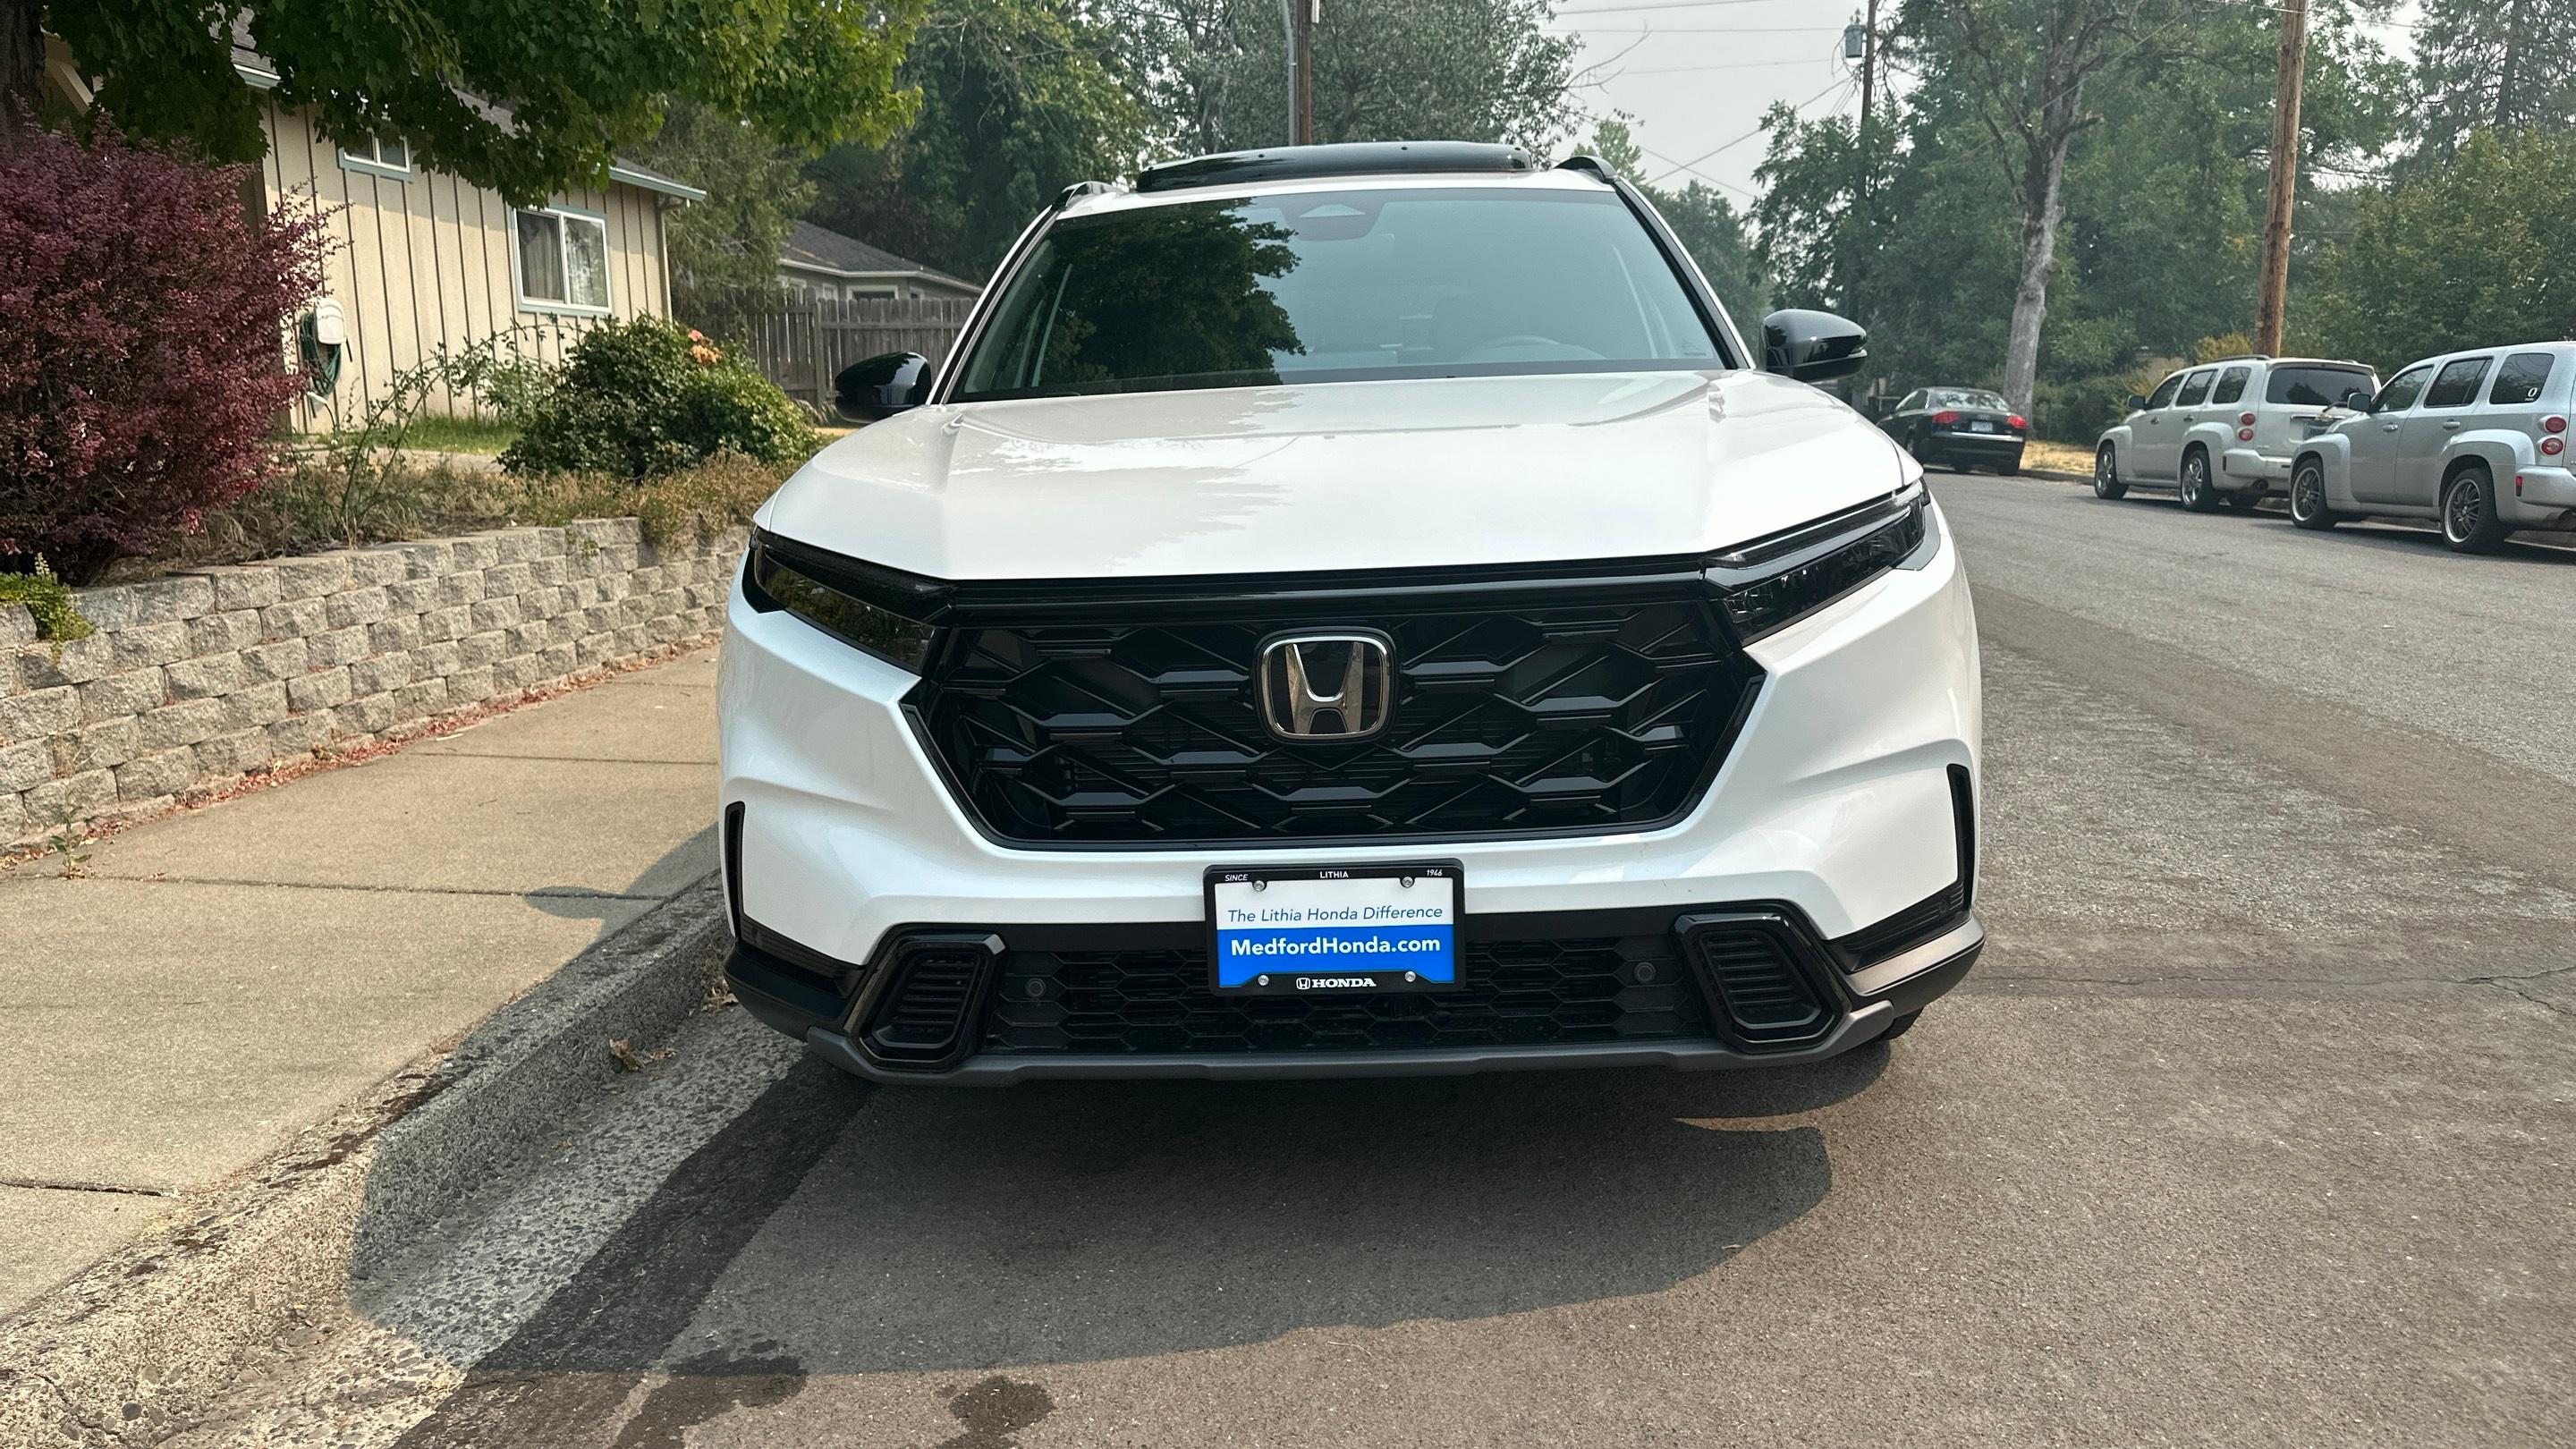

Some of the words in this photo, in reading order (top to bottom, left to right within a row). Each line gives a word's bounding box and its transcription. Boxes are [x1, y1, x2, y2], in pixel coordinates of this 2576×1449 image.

[1319, 870, 1350, 879] LITHIA
[1426, 869, 1443, 877] 1946
[1224, 874, 1249, 882] SINCE
[1228, 909, 1256, 922] The
[1261, 909, 1301, 922] Lithia
[1308, 907, 1358, 921] Honda
[1363, 905, 1443, 920] Difference
[1231, 936, 1440, 956] MedfordHonda.com
[1311, 978, 1377, 988] HONDA
